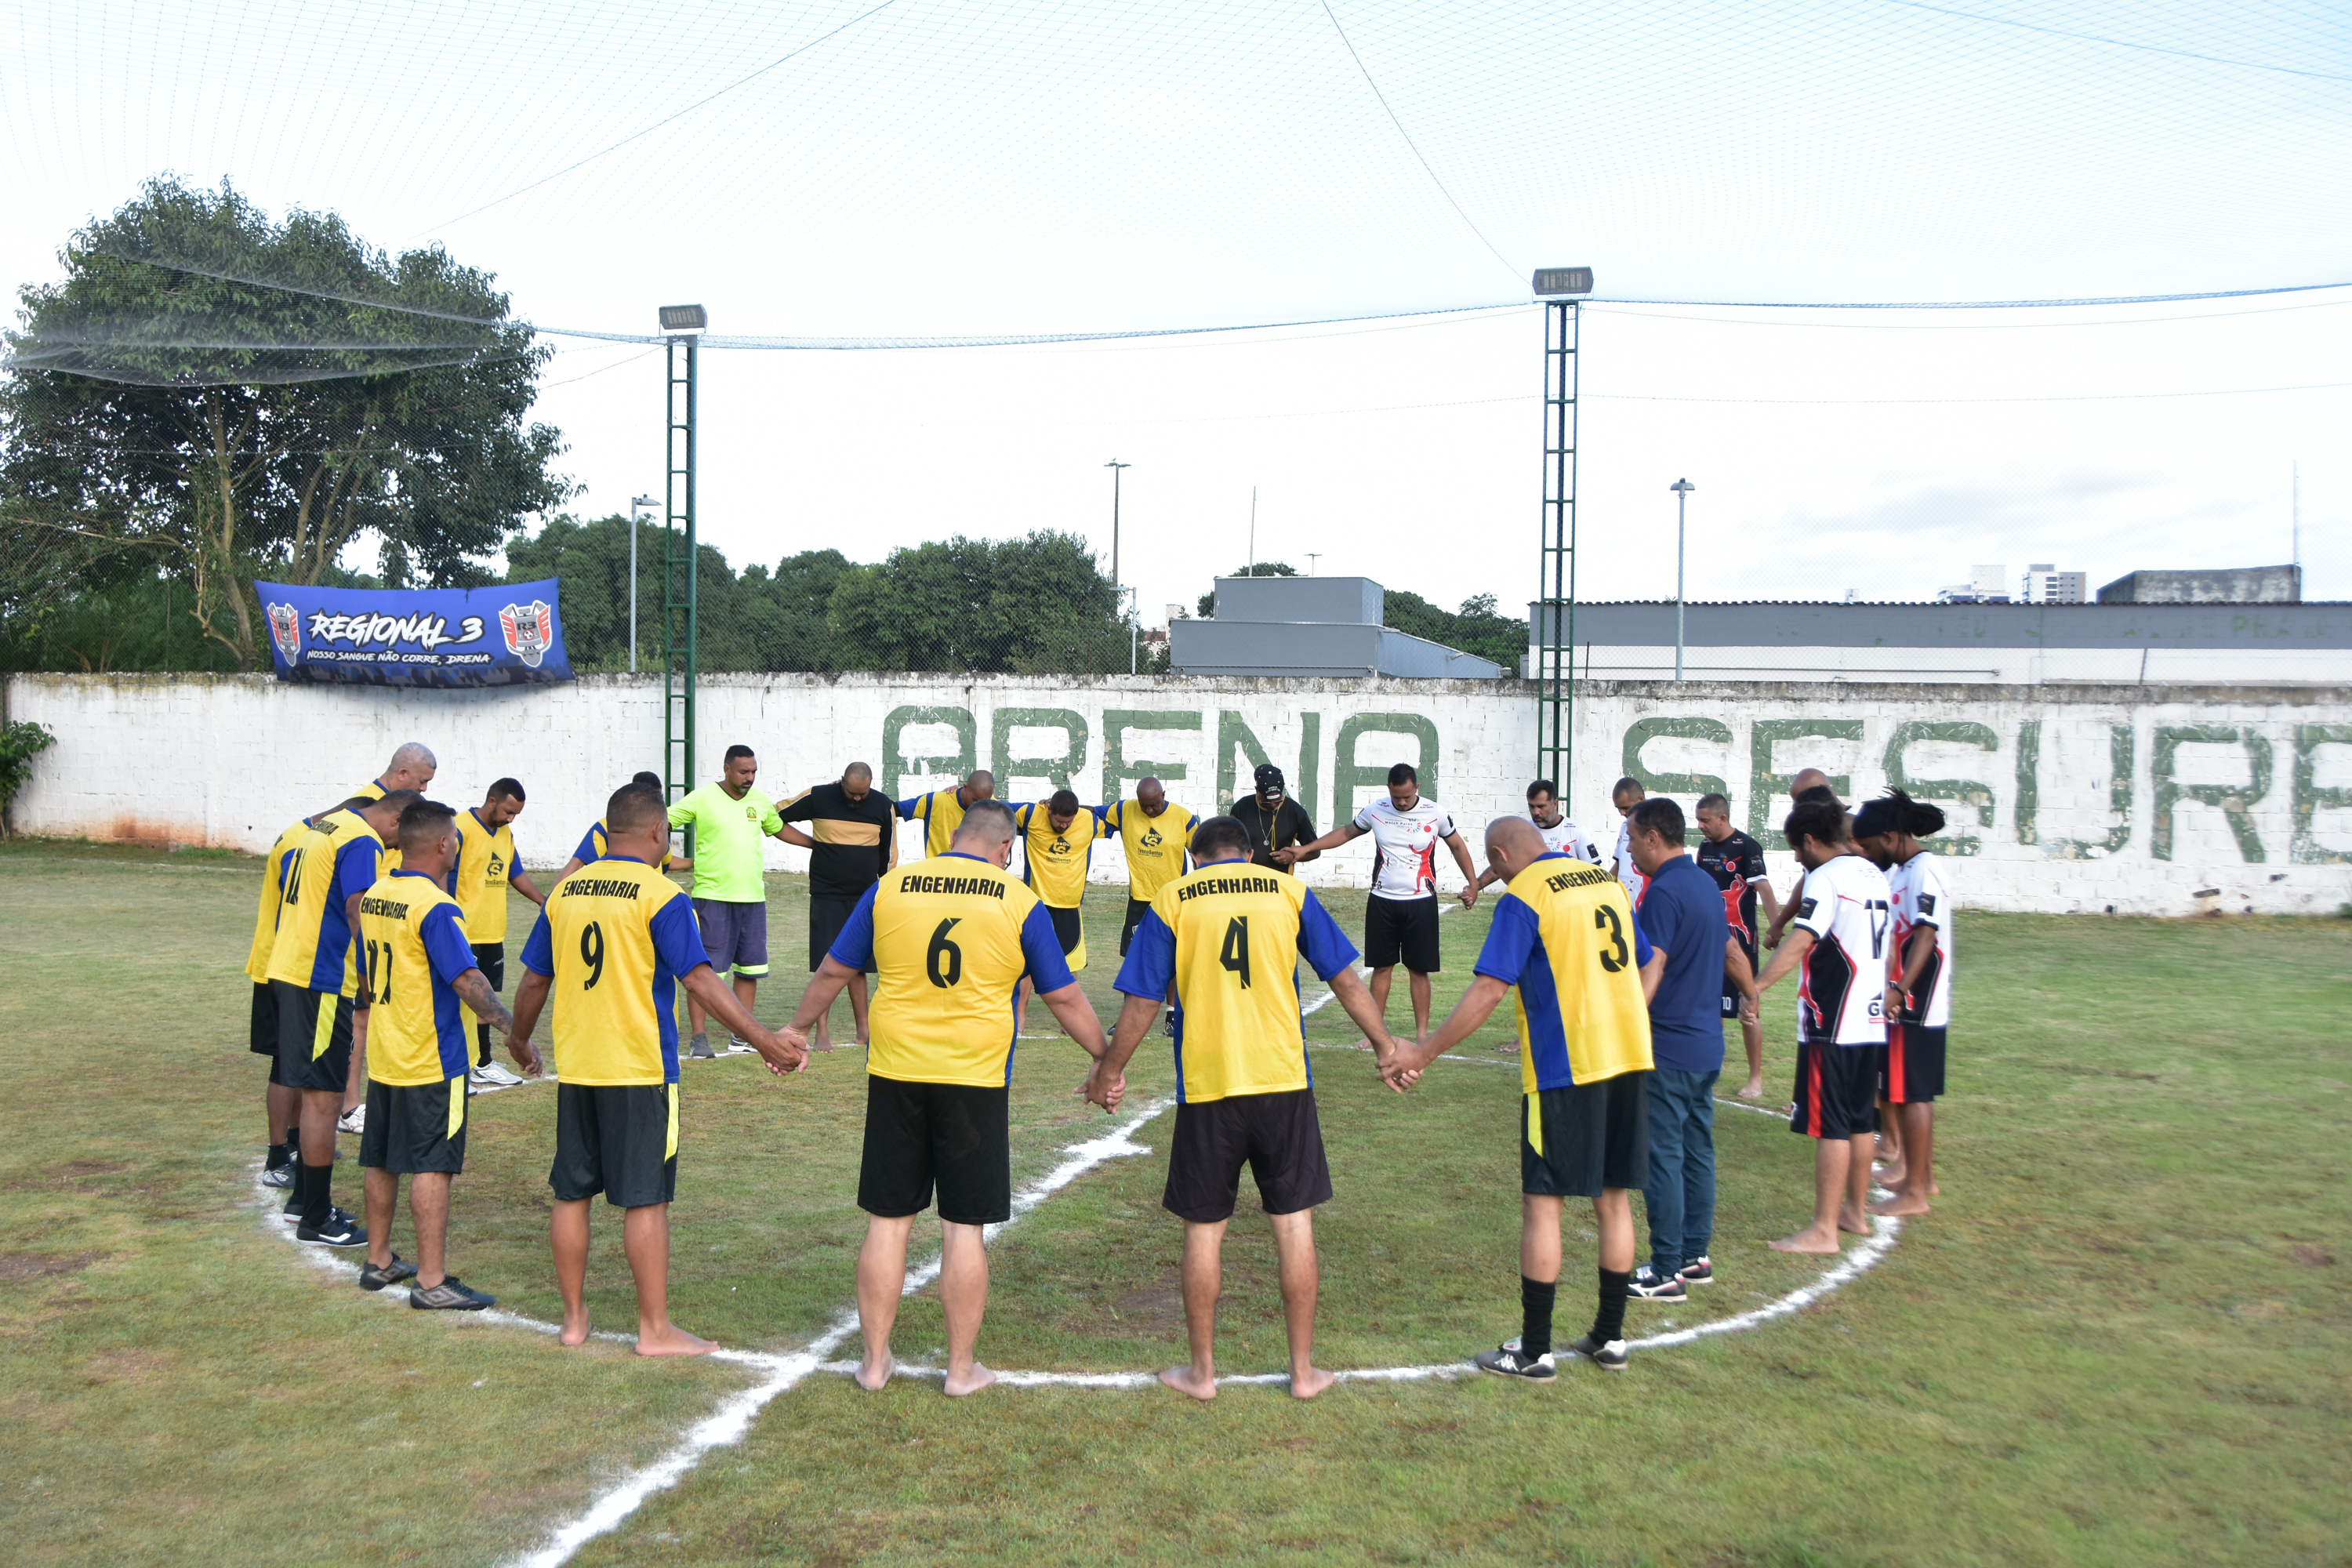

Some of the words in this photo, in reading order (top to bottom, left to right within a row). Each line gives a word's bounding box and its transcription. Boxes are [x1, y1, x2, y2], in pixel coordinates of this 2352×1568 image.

[307, 611, 454, 652] REGIONAL
[454, 617, 484, 643] 3
[307, 650, 336, 660] NOSSO
[336, 652, 376, 662] SANGUE
[377, 651, 399, 662] NÃO
[882, 705, 1439, 829] ARENA
[561, 879, 641, 900] ENGENHARIA
[900, 875, 1005, 901] ENGENHARIA
[1177, 877, 1279, 902] ENGENHARIA
[580, 920, 604, 991] 9
[927, 917, 963, 989] 6
[1220, 916, 1251, 989] 4
[1595, 904, 1628, 973] 3
[1864, 898, 1889, 960] 17
